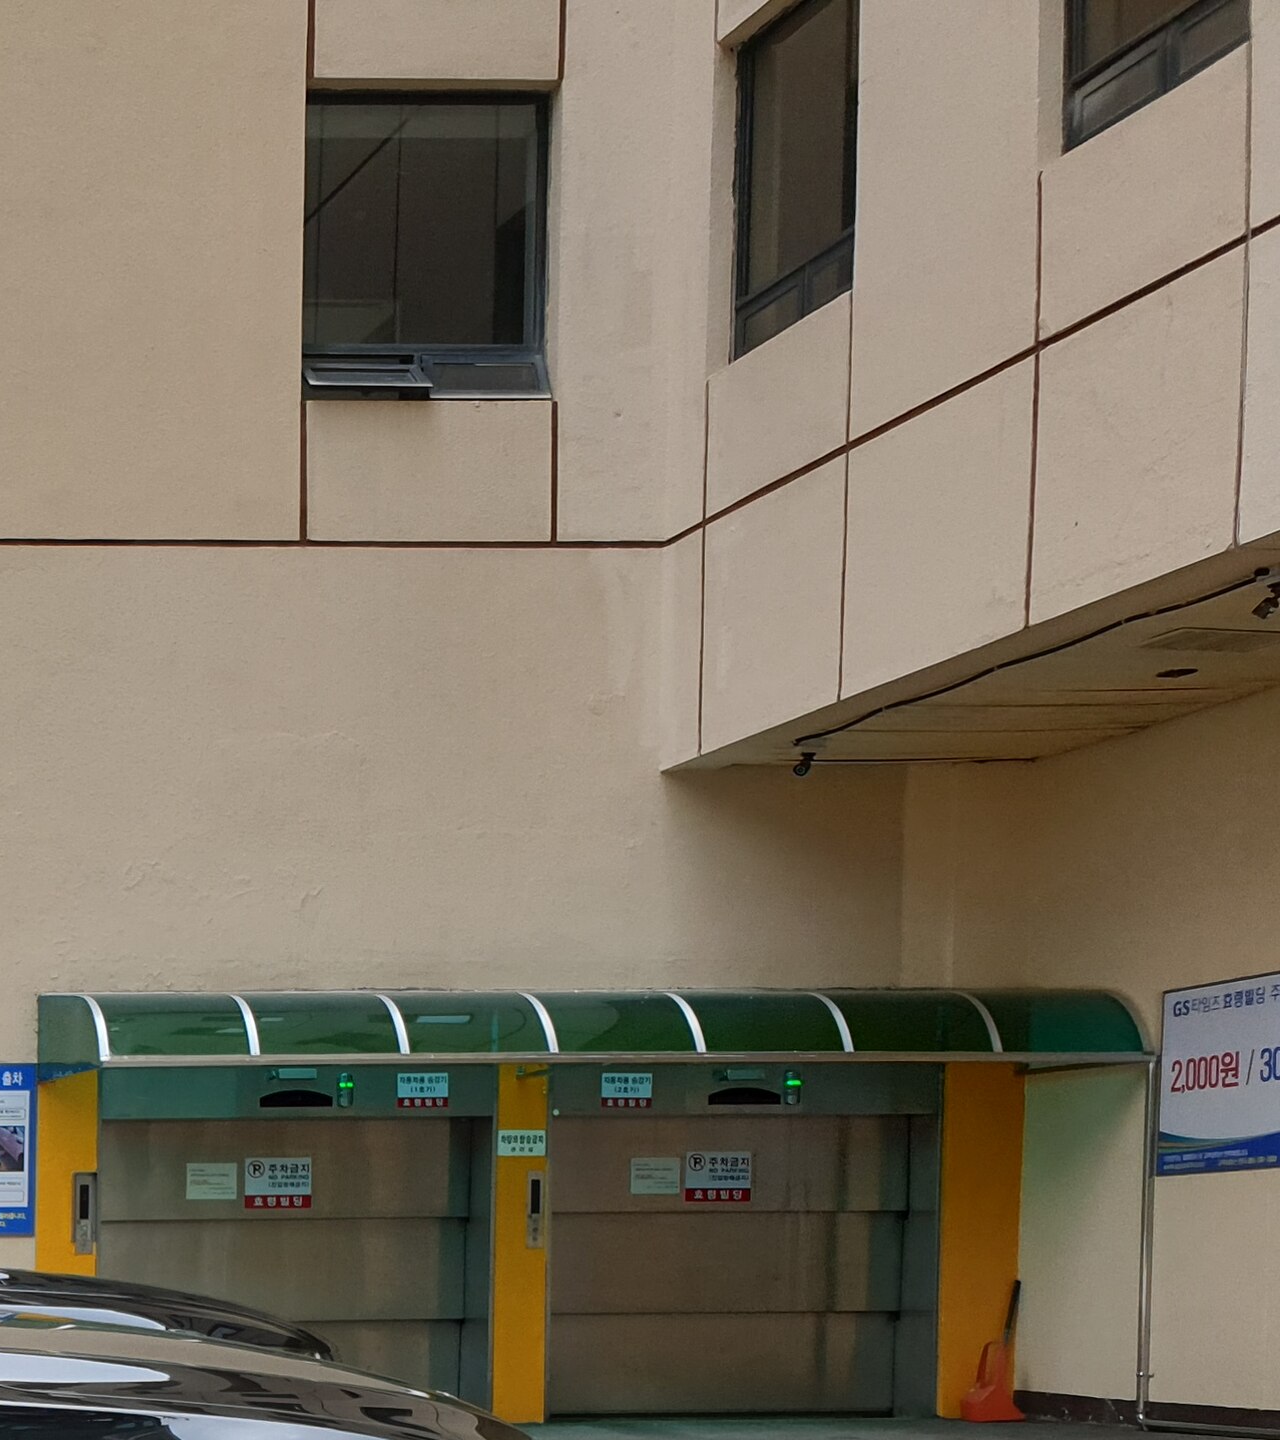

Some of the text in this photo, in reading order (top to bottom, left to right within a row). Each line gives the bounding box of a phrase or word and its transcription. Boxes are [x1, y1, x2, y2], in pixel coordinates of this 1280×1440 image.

[1170, 1050, 1240, 1094] 2,000원
[2, 1071, 23, 1087] 출차
[268, 1163, 310, 1174] 주차금지
[708, 1157, 750, 1167] 주차금지
